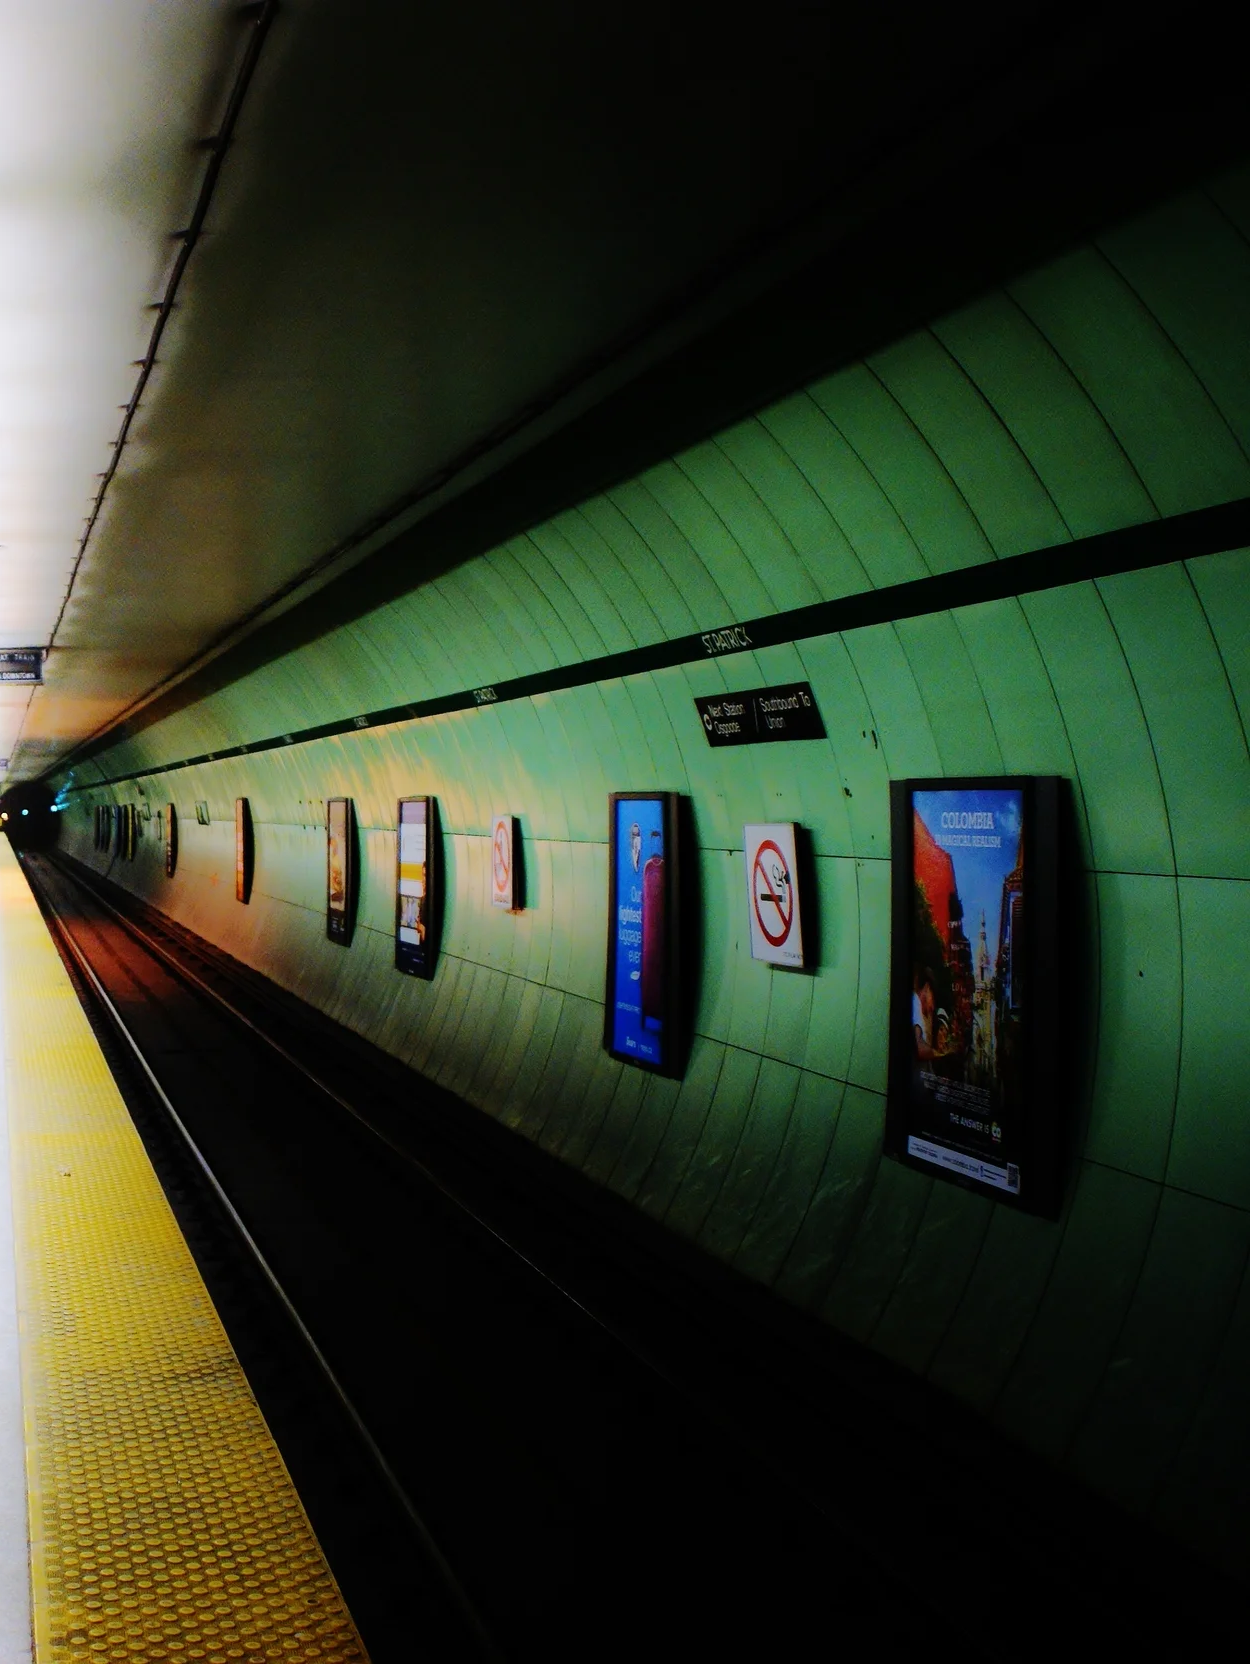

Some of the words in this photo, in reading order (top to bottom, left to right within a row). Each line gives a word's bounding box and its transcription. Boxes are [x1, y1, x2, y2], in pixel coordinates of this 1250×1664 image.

[759, 692, 799, 712] Southbound
[799, 691, 811, 707] To
[941, 811, 995, 830] COLOMBIA
[960, 1117, 983, 1132] ANSWER
